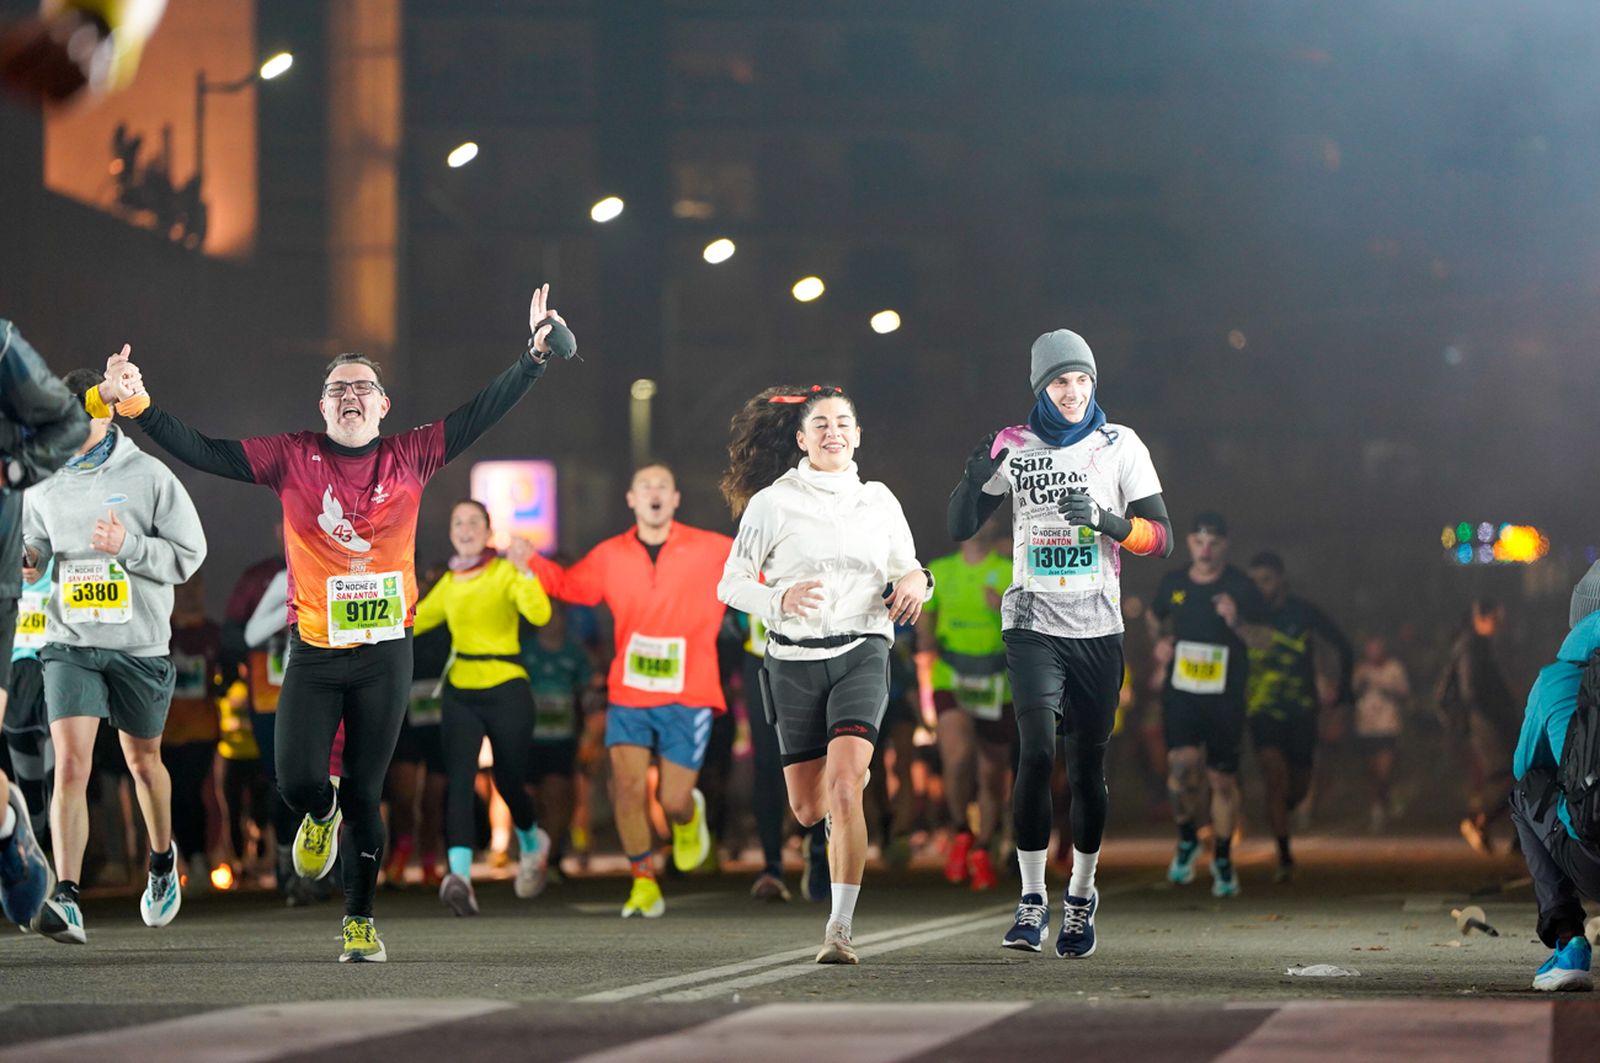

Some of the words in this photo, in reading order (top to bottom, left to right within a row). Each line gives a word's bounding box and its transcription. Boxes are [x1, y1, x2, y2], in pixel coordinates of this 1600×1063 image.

[1009, 456, 1053, 476] San
[1014, 471, 1067, 493] Juan
[332, 524, 352, 543] 43
[1032, 537, 1045, 546] SAN
[1063, 529, 1072, 537] DE
[1032, 546, 1093, 569] 13025
[72, 582, 119, 602] 5380
[345, 582, 369, 591] NOCHE
[336, 592, 352, 601] SAN
[346, 598, 389, 622] 9172
